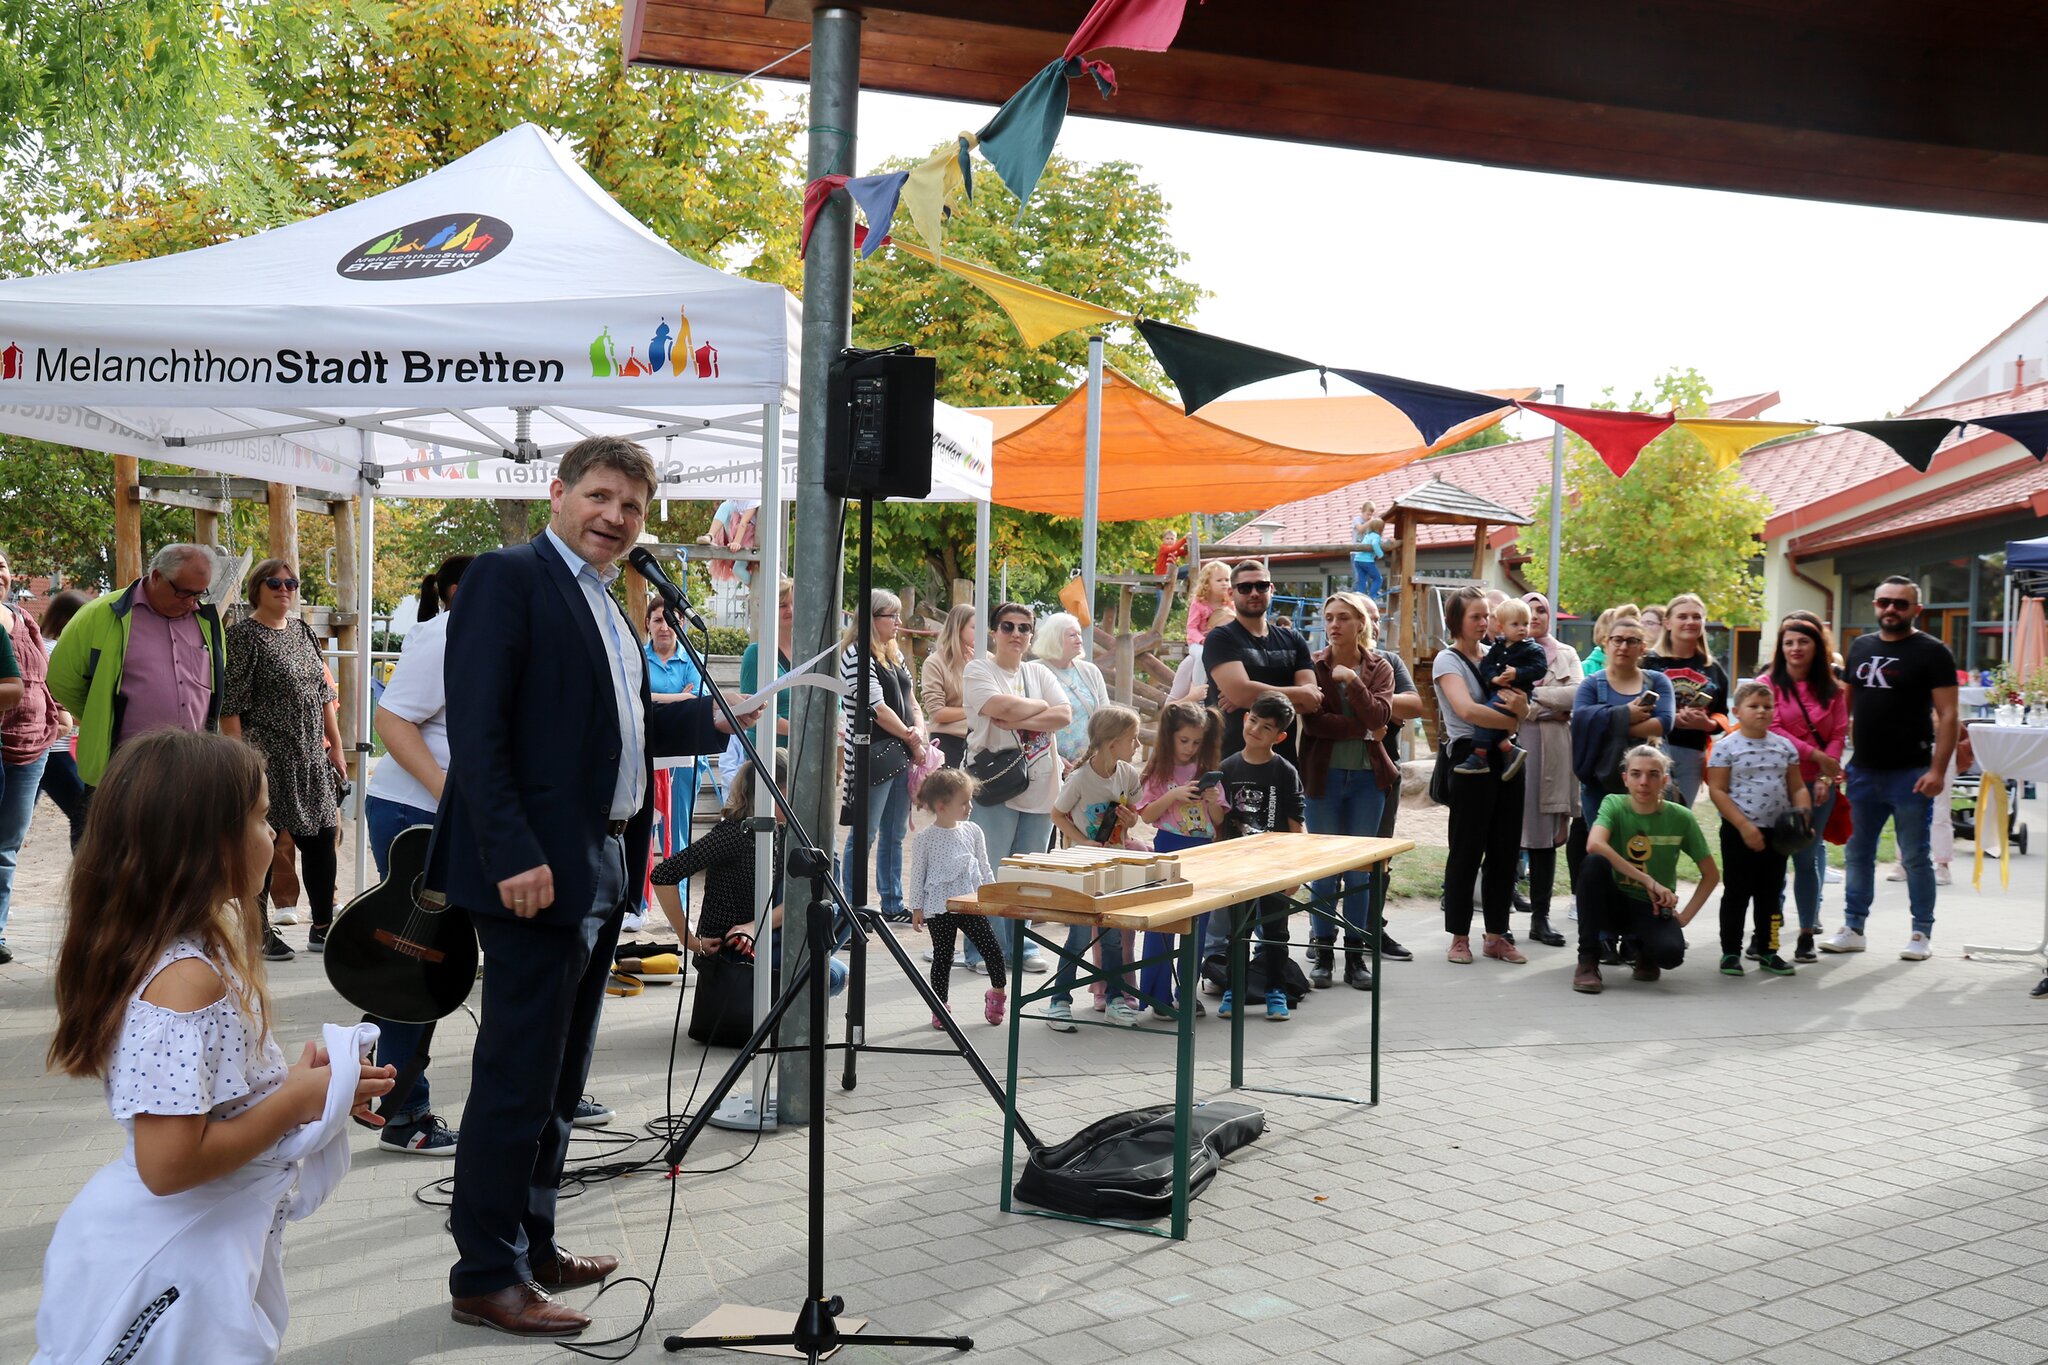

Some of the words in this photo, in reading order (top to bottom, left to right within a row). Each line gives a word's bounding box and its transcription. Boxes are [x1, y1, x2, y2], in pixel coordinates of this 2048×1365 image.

[343, 258, 475, 273] BRETTEN
[36, 347, 389, 384] MelanchthonStadt
[402, 350, 564, 383] Bretten
